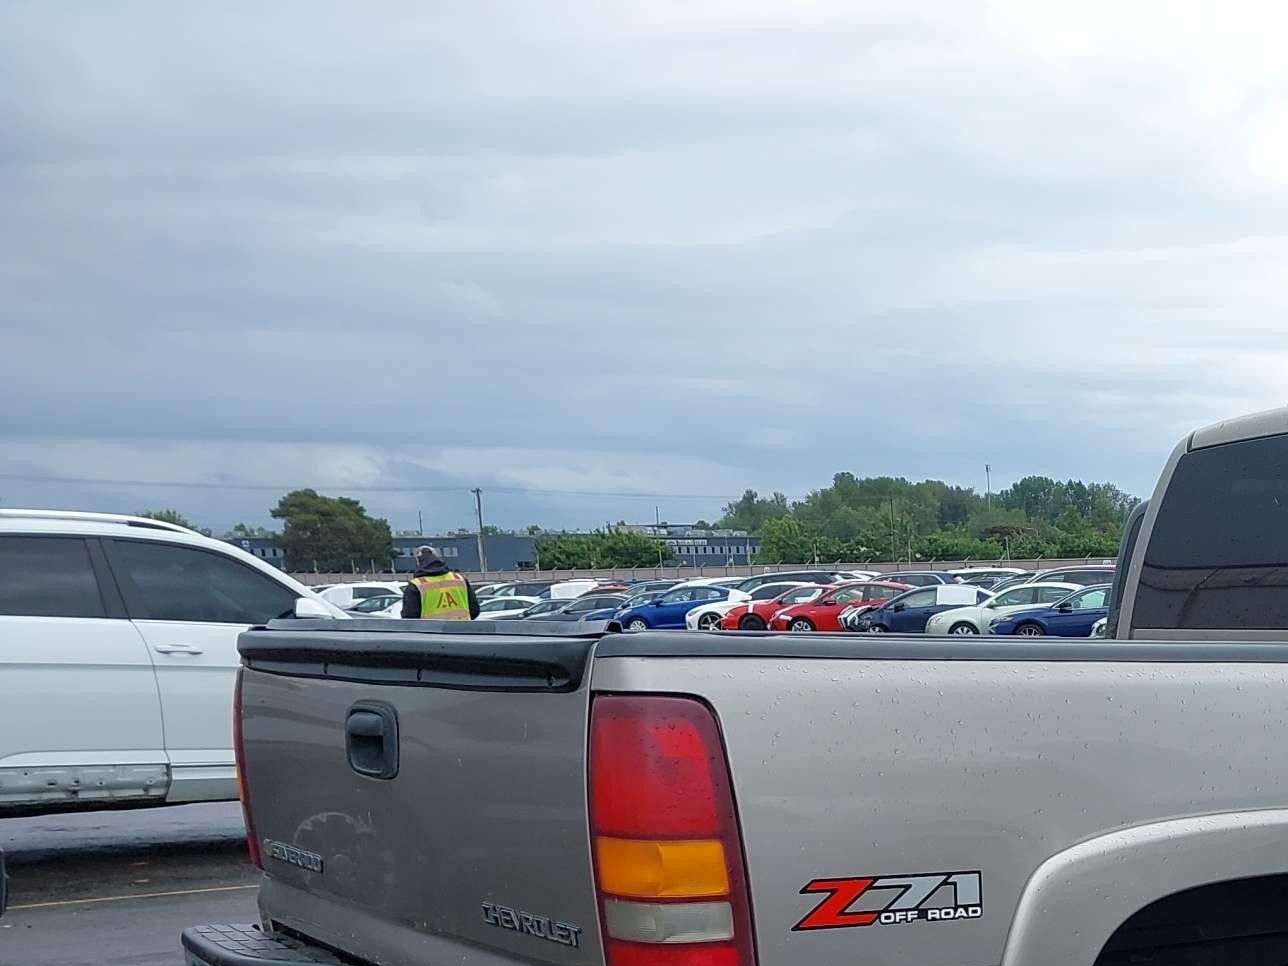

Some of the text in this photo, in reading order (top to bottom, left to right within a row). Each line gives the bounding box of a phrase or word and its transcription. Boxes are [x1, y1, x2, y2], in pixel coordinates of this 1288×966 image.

[791, 870, 983, 931] Z71
[880, 906, 982, 924] OFF ROAD
[481, 901, 583, 948] CHEVROLET
